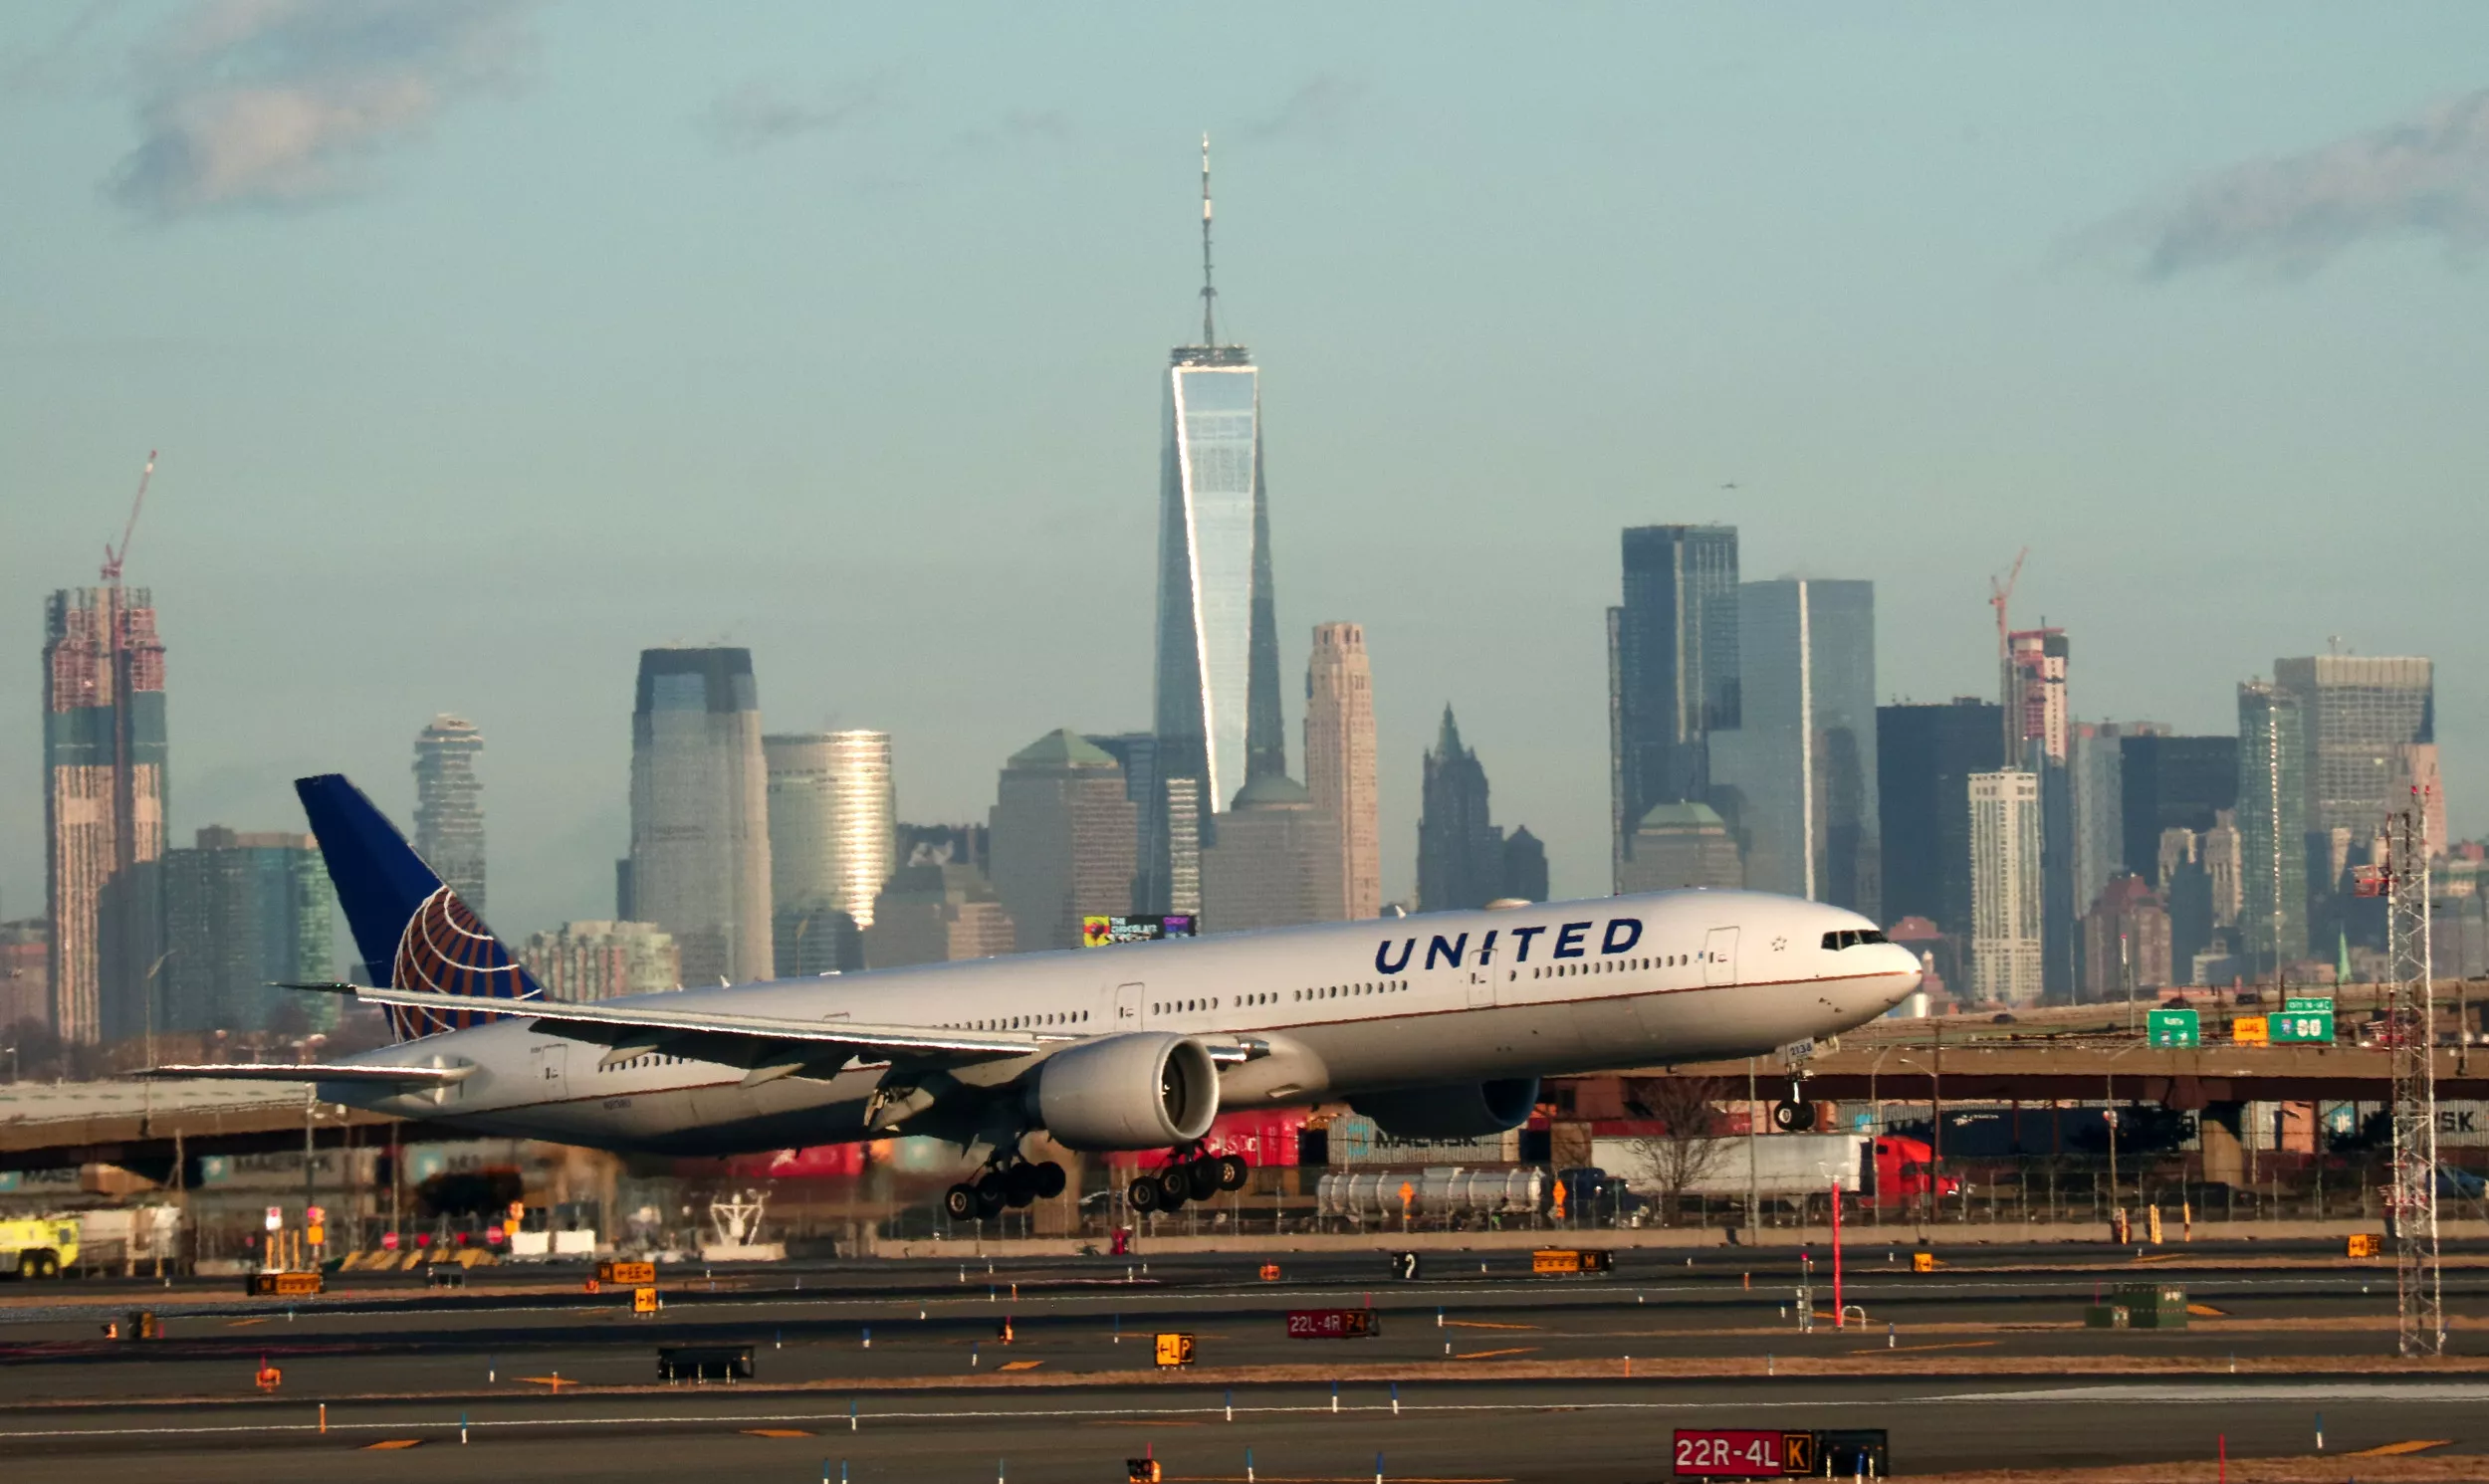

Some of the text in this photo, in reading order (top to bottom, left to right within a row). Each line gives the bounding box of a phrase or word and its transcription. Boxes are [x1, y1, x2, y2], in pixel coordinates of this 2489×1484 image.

[1375, 918, 1644, 974] UNITED
[1290, 1315, 1341, 1332] 22L-4R
[1181, 1339, 1191, 1359] P
[1676, 1439, 1805, 1468] 22R-4L K
